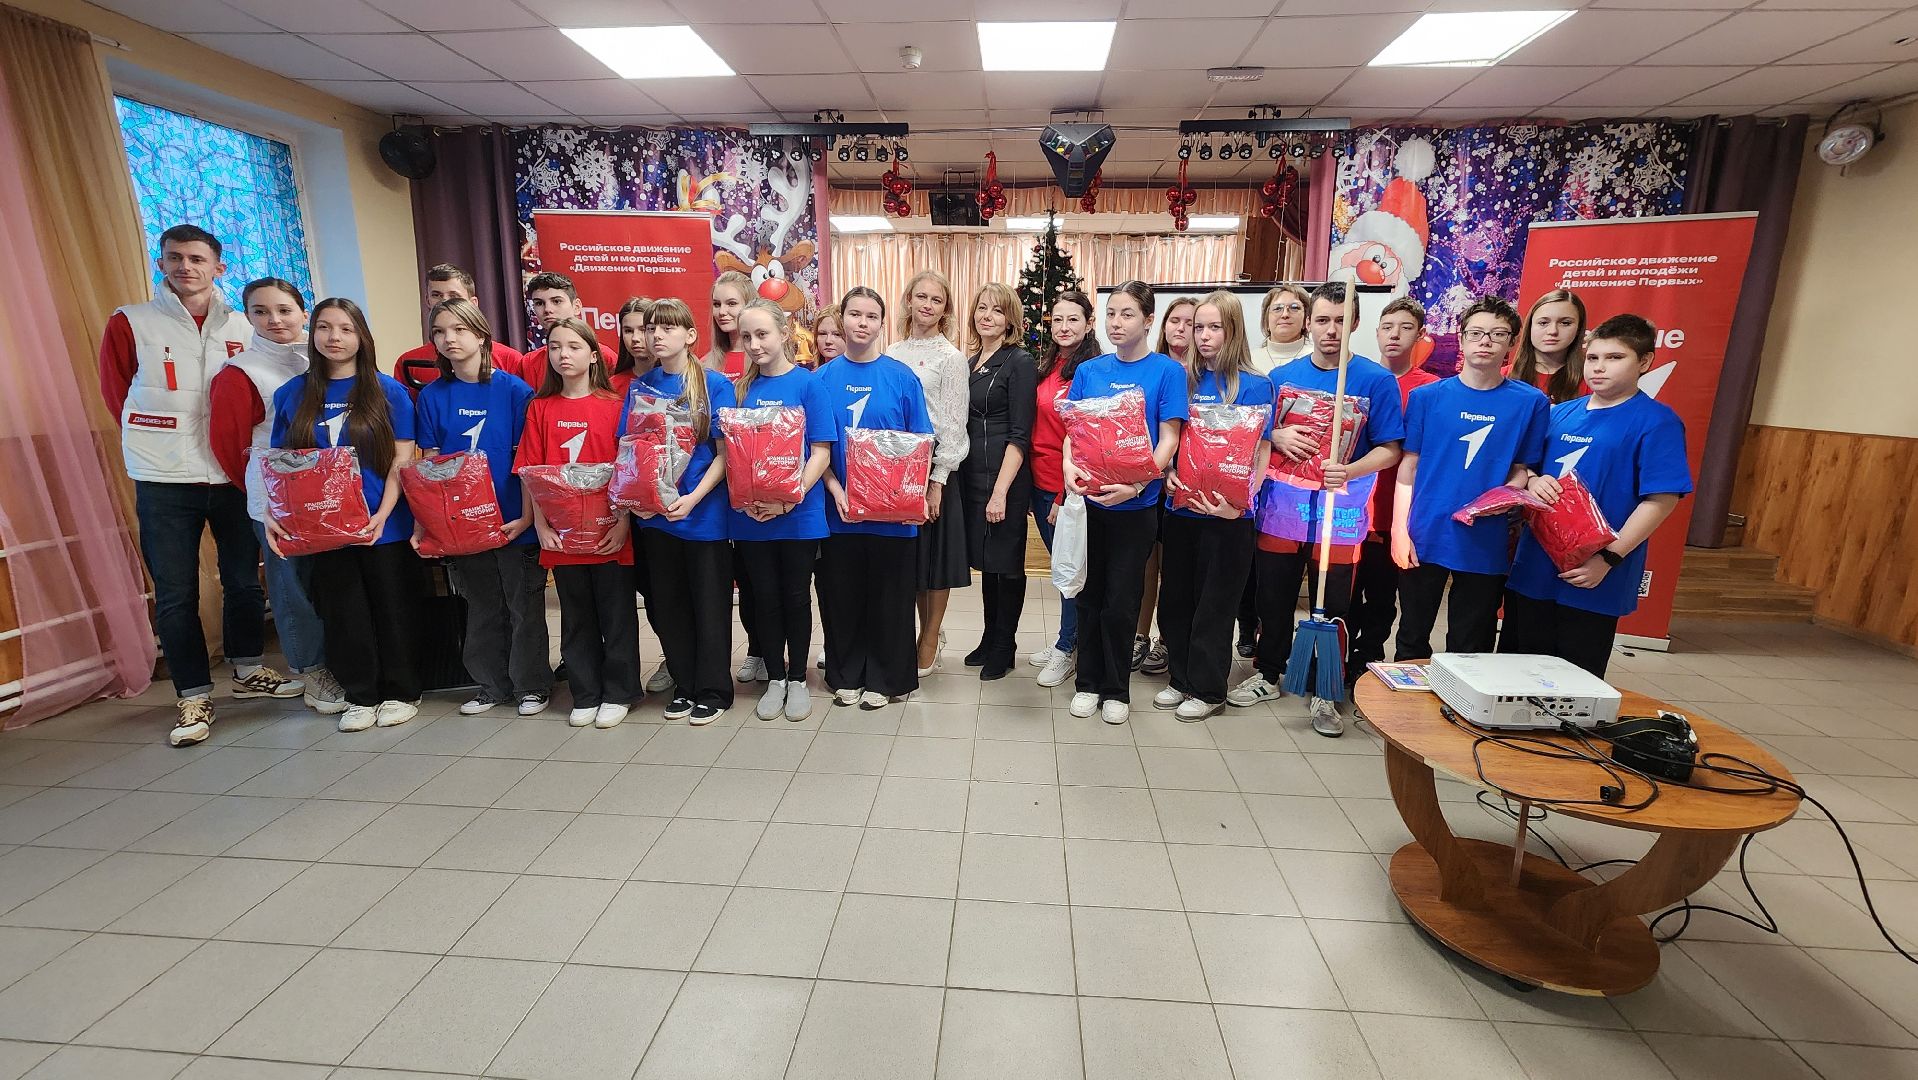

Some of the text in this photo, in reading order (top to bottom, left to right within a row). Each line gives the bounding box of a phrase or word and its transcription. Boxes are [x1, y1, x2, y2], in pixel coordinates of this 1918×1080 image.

[559, 243, 692, 254] Российское движение
[574, 254, 609, 263] детей
[620, 255, 681, 264] молодёжи
[1549, 255, 1718, 268] Российское движение
[570, 264, 687, 274] «Движение Первых»
[1562, 267, 1605, 278] детей
[1619, 266, 1699, 277] молодёжи
[1554, 277, 1703, 289] «Движение Первых»
[846, 384, 872, 394] Первые
[458, 408, 488, 417] Первые
[1460, 411, 1496, 423] Первые
[557, 420, 588, 429] Первые
[1560, 433, 1593, 444] Первые
